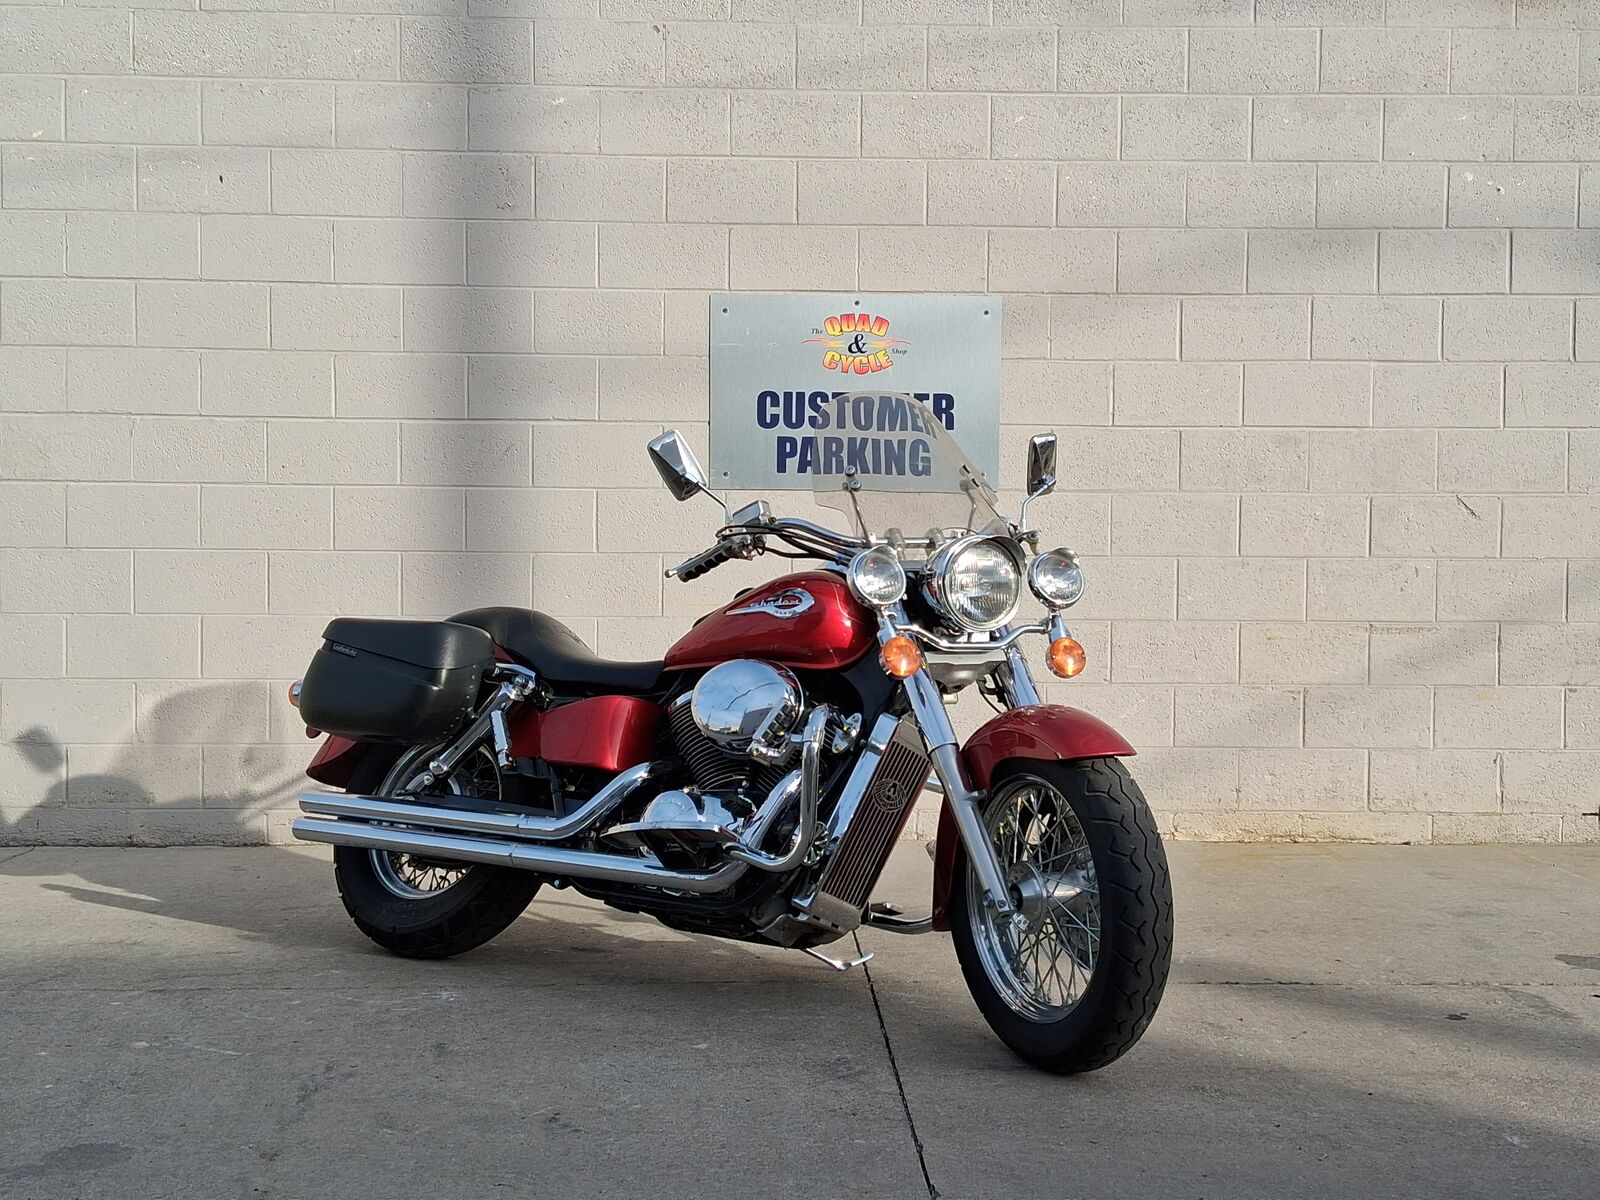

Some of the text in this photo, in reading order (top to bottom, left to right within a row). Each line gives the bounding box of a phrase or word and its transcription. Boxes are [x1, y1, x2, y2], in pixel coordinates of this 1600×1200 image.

[824, 313, 889, 337] QUAD
[848, 334, 867, 354] &
[823, 349, 893, 375] CYCLE
[756, 390, 955, 432] CUSTOMER
[776, 436, 932, 477] PARKING
